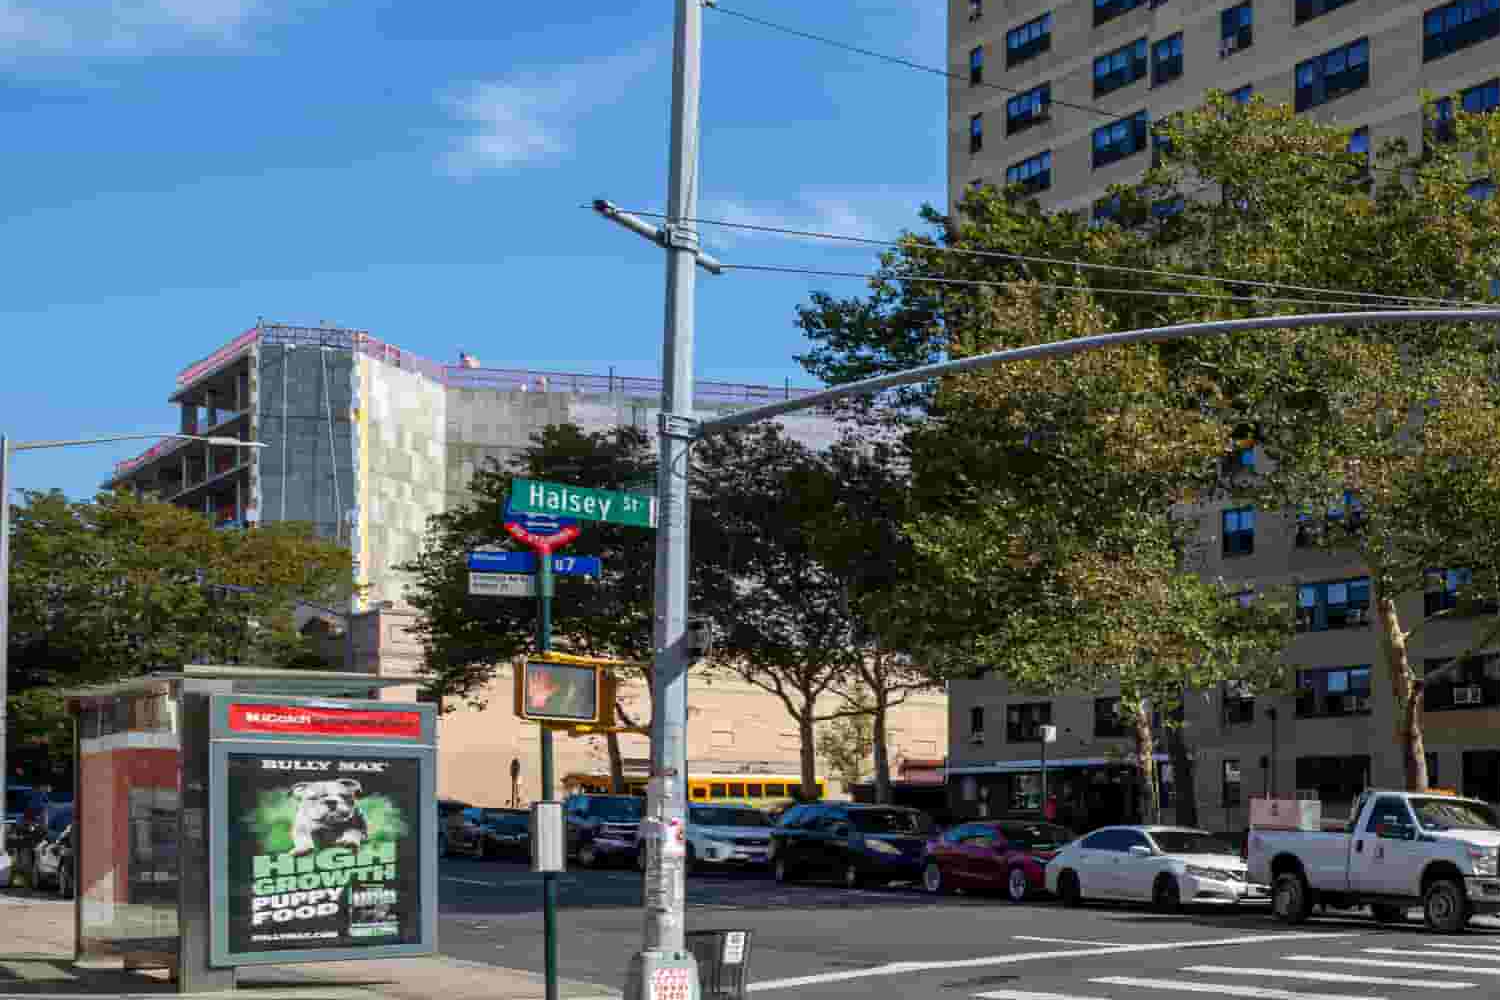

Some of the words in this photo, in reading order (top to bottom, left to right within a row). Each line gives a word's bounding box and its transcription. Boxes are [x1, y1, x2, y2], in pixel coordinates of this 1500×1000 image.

[529, 482, 611, 521] Halsey
[261, 759, 331, 771] BULLY
[337, 760, 385, 772] MAX
[254, 842, 396, 878] HIGH
[255, 864, 396, 896] GROWTH
[252, 887, 344, 911] PUPPY
[252, 903, 339, 925] FOOD
